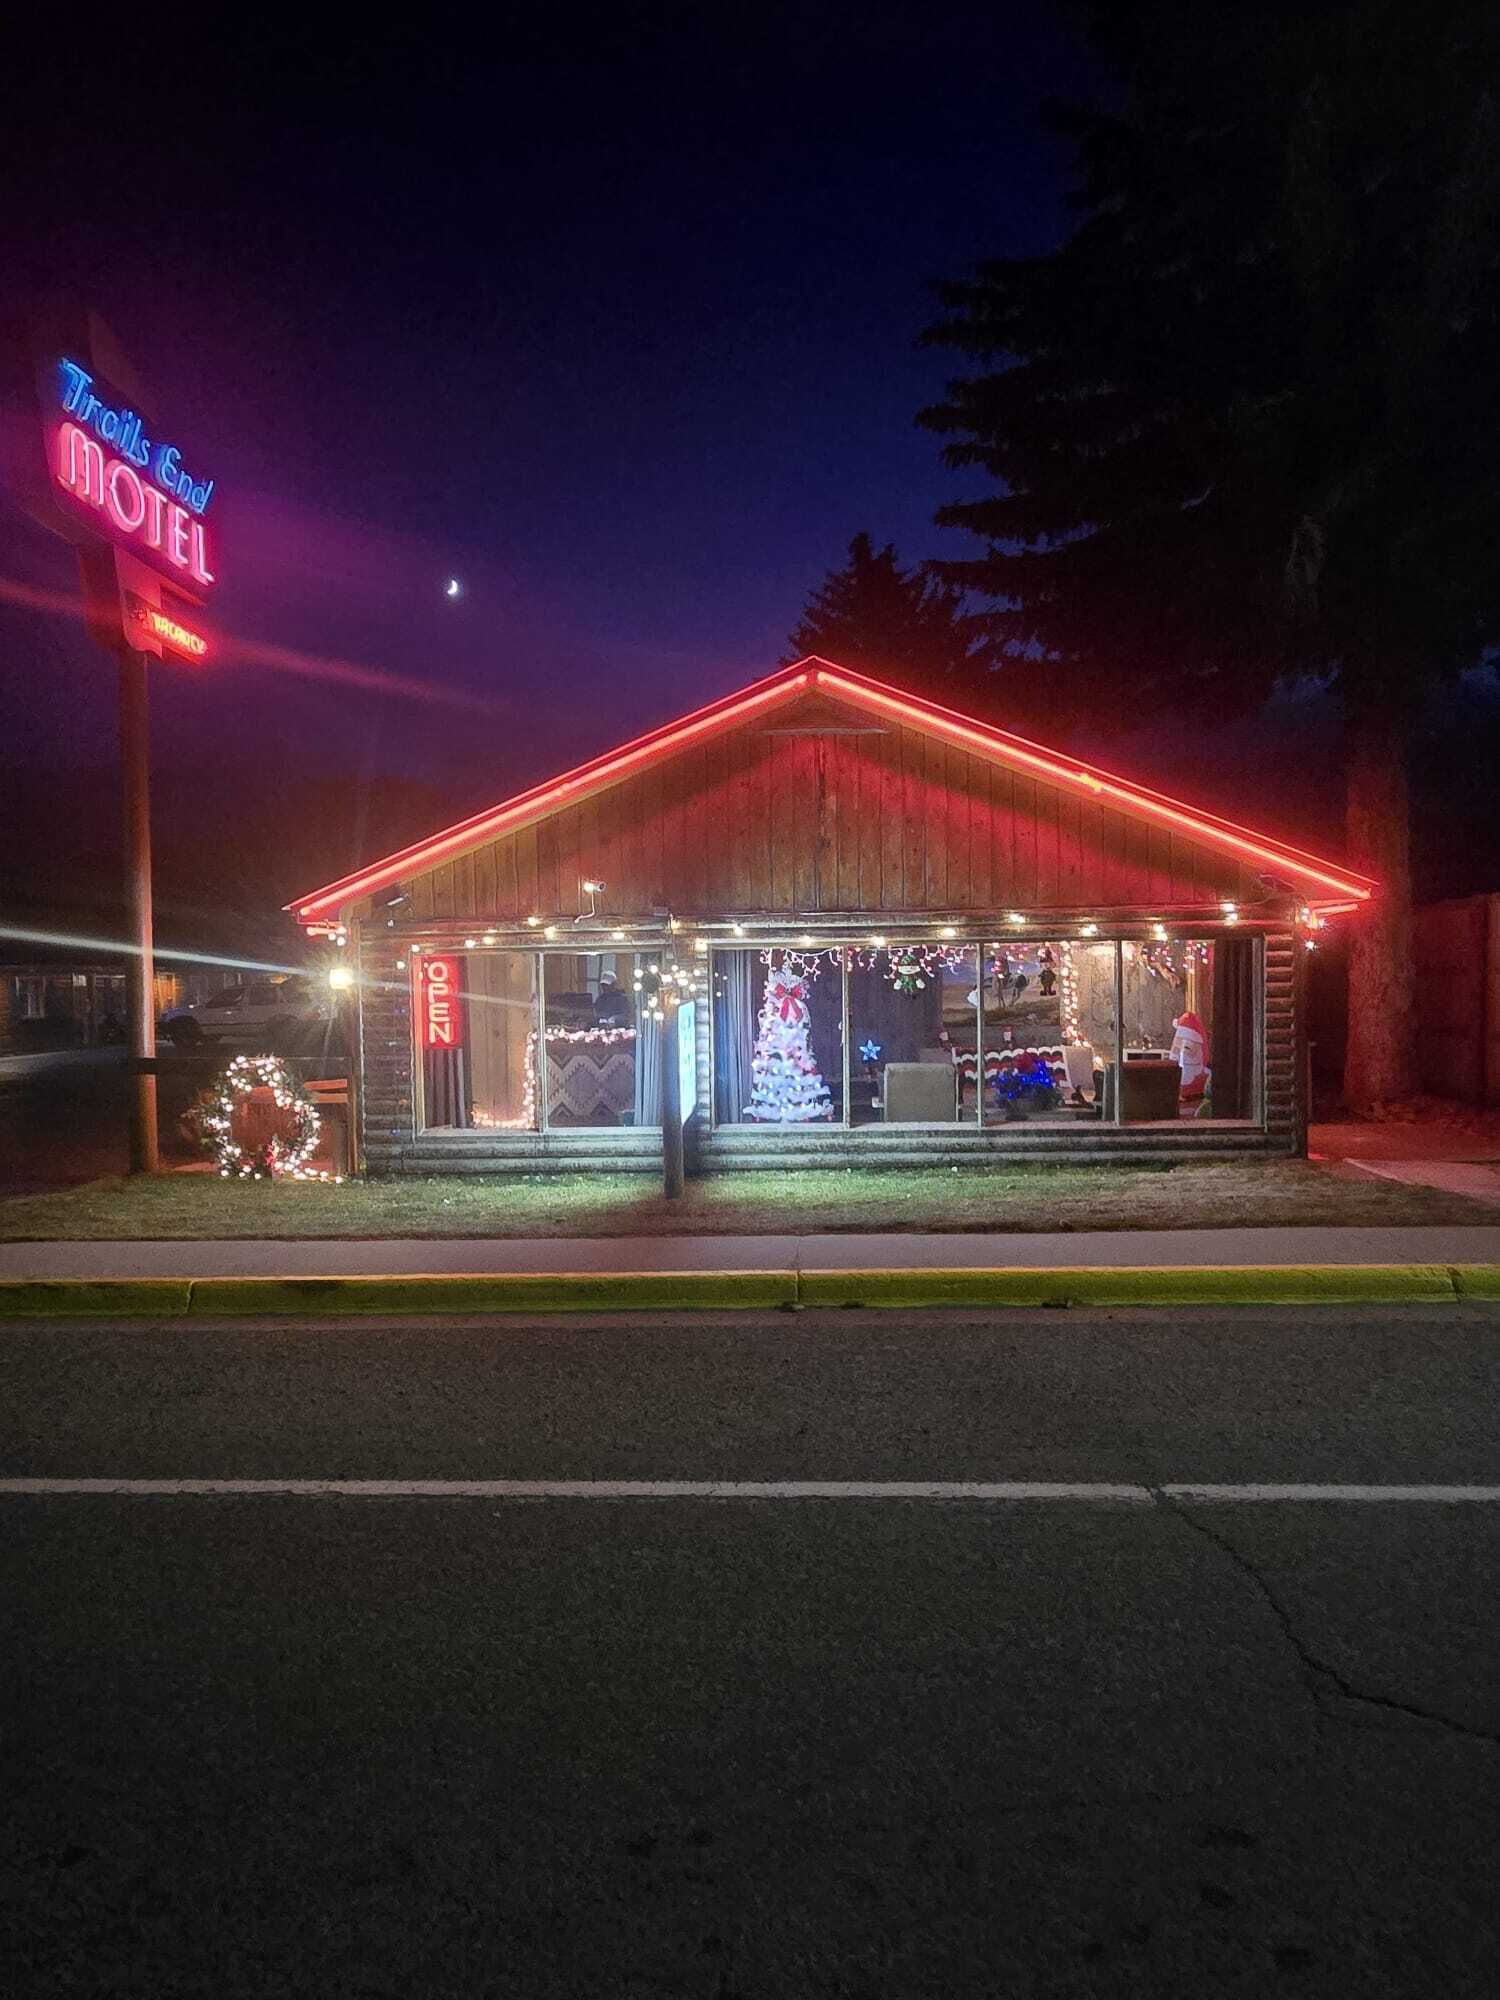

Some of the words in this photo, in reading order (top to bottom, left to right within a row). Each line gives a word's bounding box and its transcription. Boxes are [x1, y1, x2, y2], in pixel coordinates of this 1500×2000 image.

[57, 422, 216, 587] MOTEL
[58, 358, 152, 468] Trails
[154, 444, 215, 515] End
[428, 961, 452, 1043] OPEN
